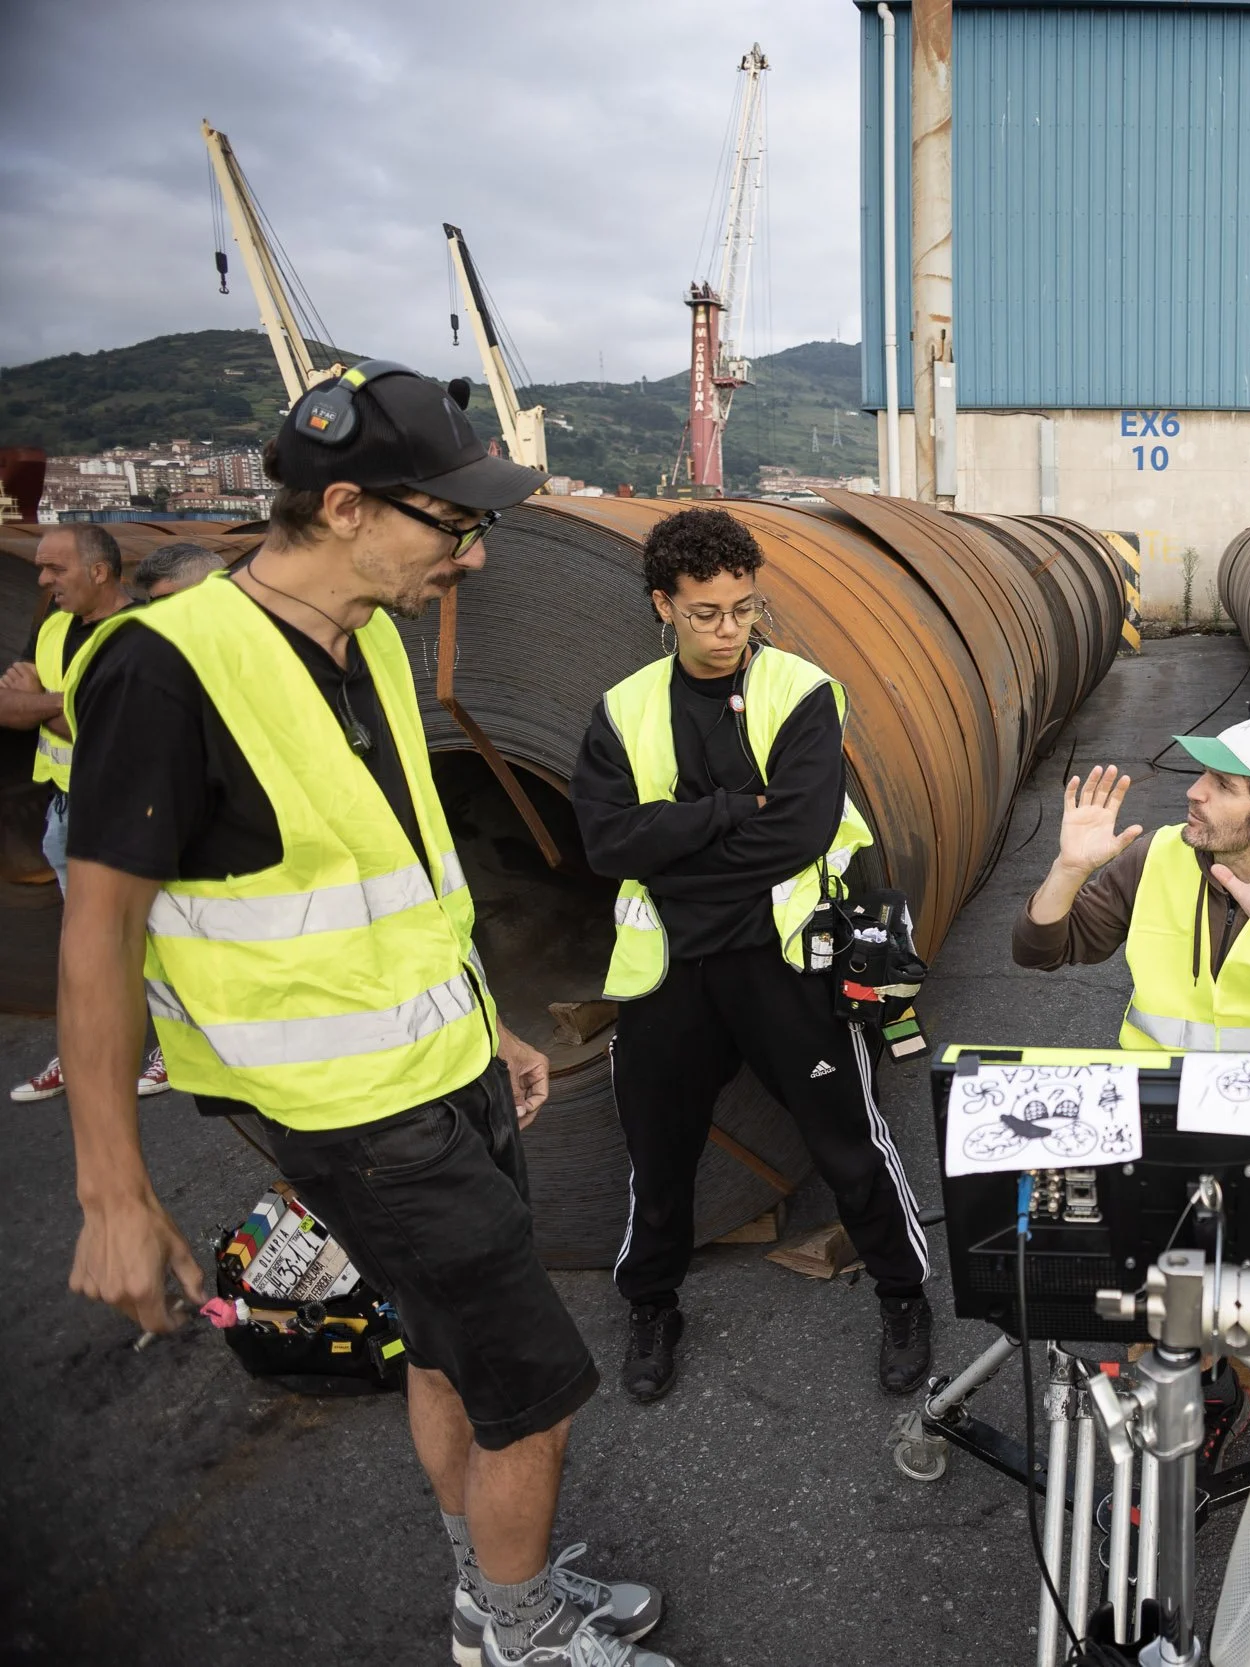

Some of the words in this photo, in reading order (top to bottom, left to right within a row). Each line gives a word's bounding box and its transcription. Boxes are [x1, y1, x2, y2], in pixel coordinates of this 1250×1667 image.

[694, 342, 704, 412] CANDINA
[1121, 411, 1180, 437] EX6
[1132, 446, 1169, 471] 10
[810, 1066, 836, 1078] adidas
[258, 1229, 289, 1268] OLIMPIA
